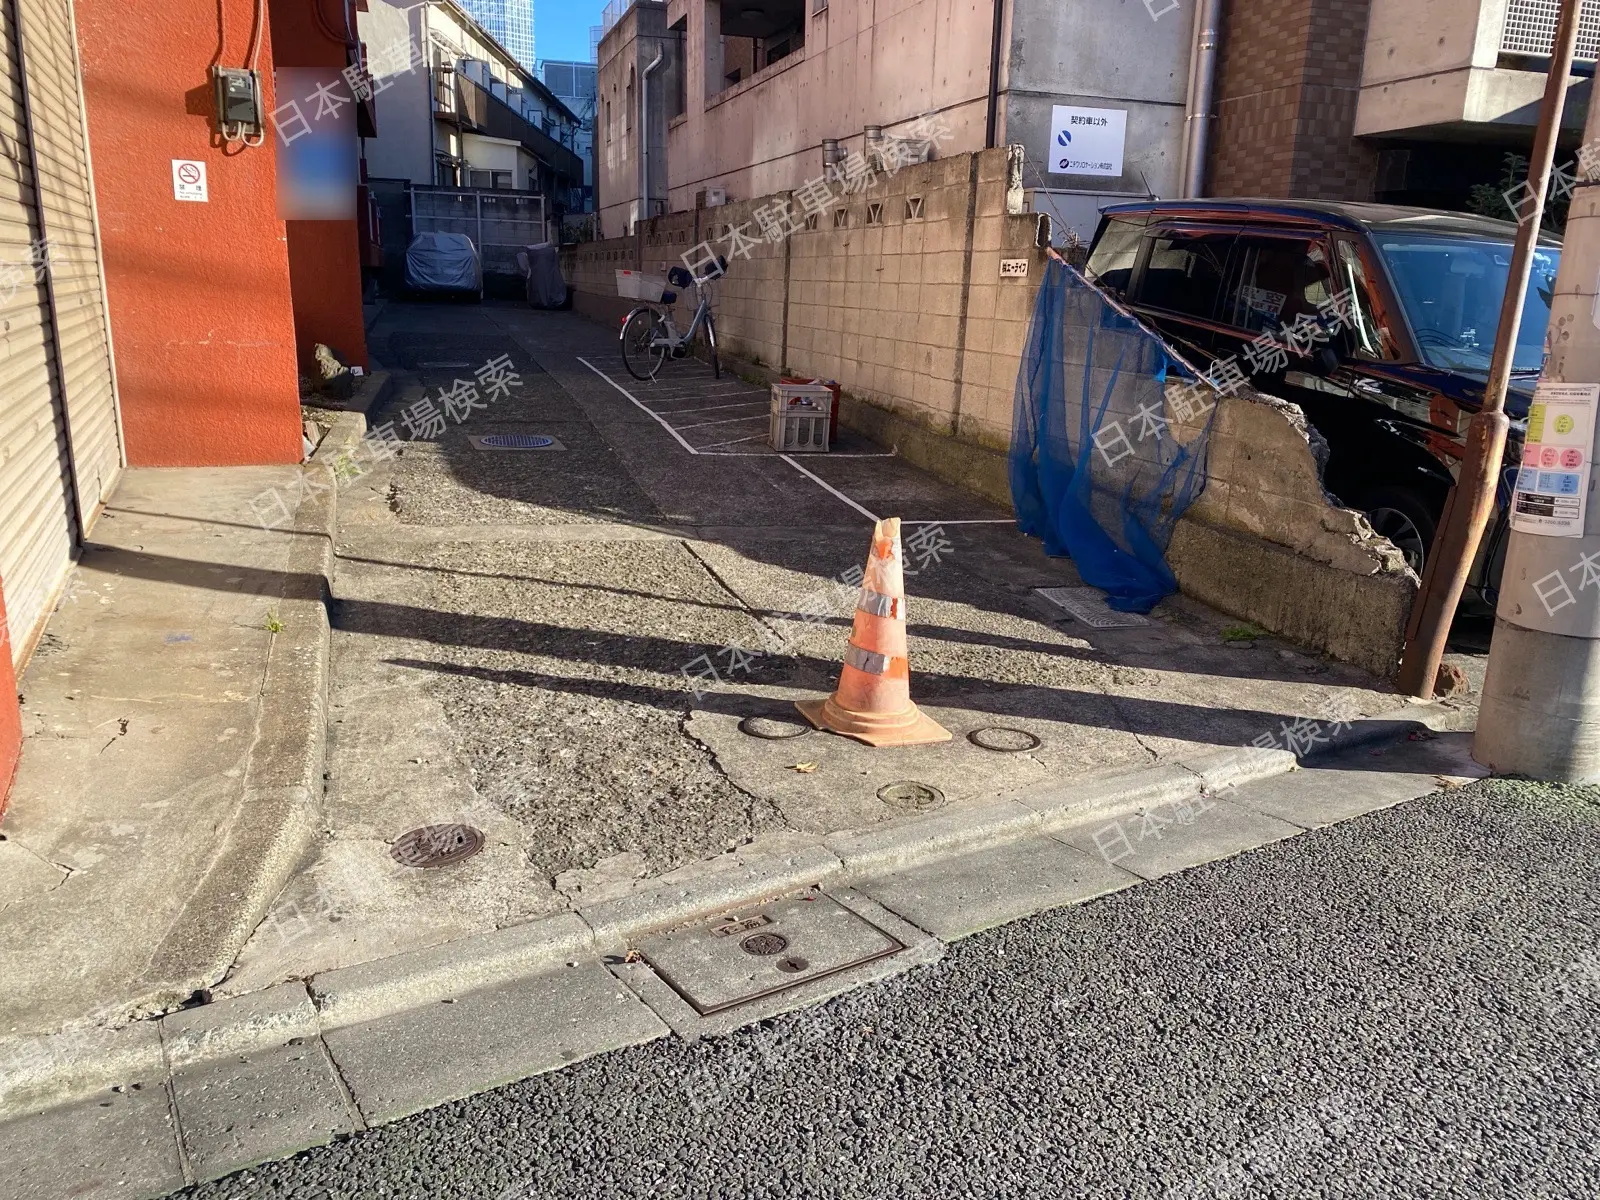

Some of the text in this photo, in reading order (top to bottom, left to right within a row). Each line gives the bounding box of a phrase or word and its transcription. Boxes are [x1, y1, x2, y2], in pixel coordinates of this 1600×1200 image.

[1070, 115, 1108, 127] 契約車以外
